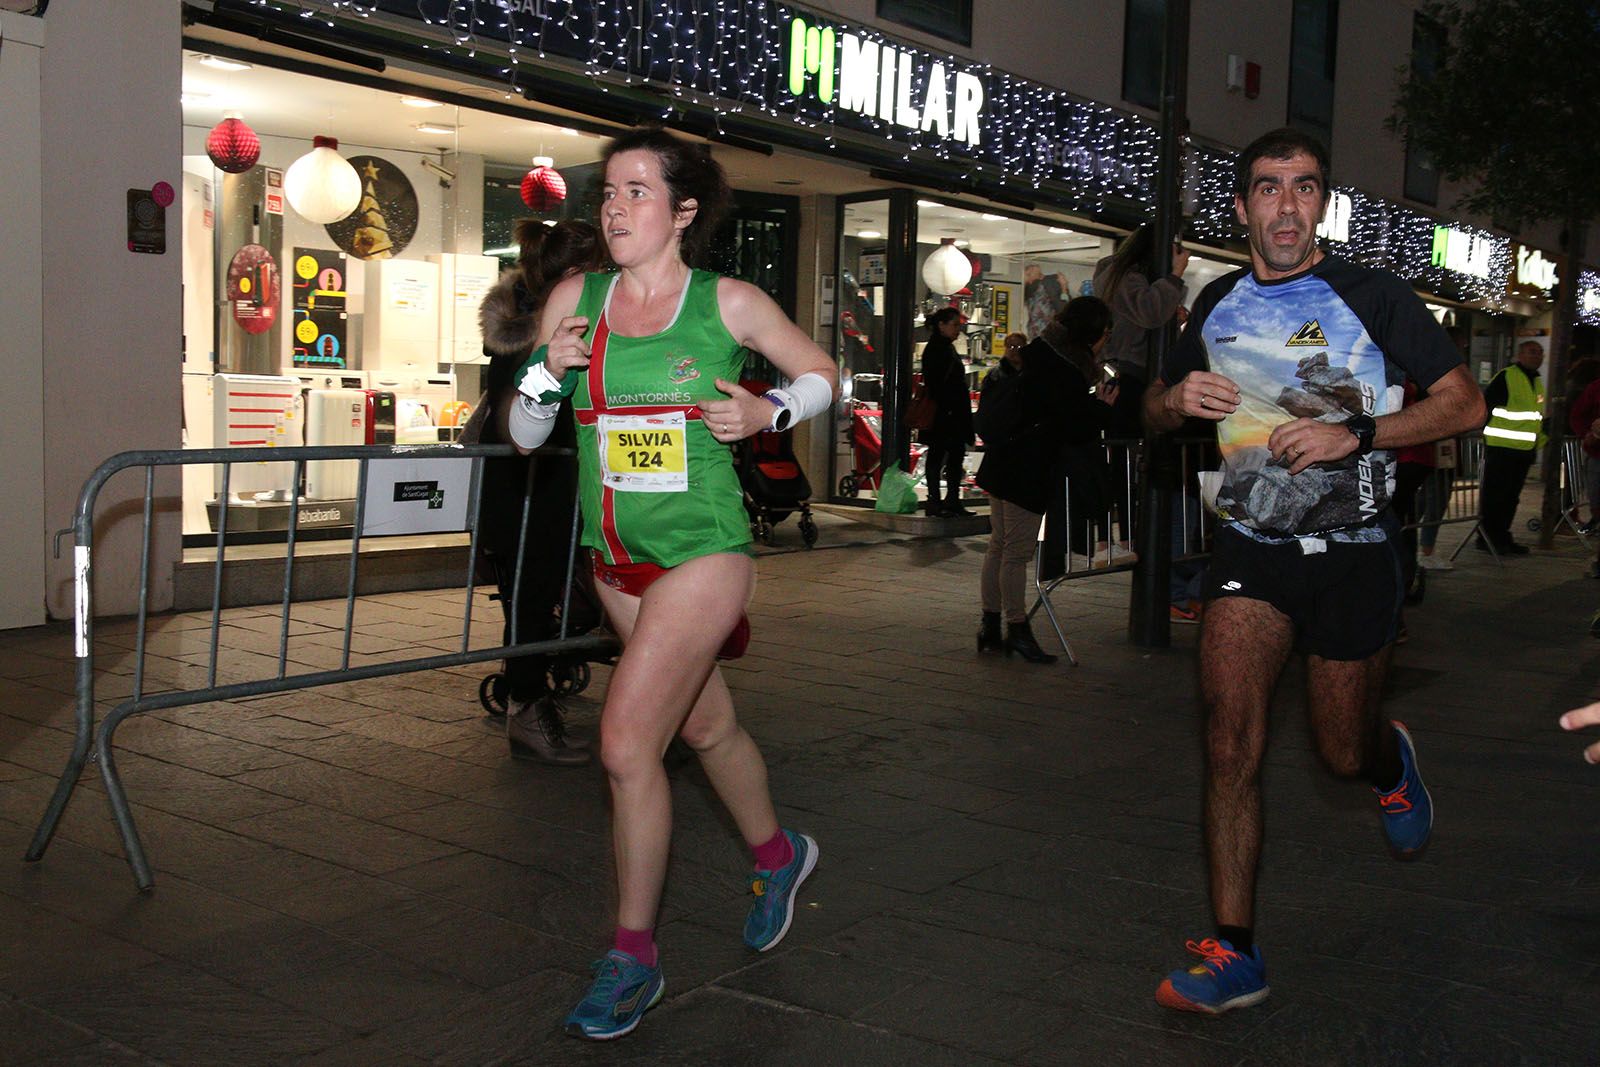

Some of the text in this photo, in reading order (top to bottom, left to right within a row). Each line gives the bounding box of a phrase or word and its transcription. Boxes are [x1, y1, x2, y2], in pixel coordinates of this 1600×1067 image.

[839, 33, 983, 145] MILAR
[608, 388, 692, 404] MONTORNÈS
[618, 433, 673, 447] SILVIA
[628, 451, 663, 467] 124
[305, 508, 341, 522] brabantia
